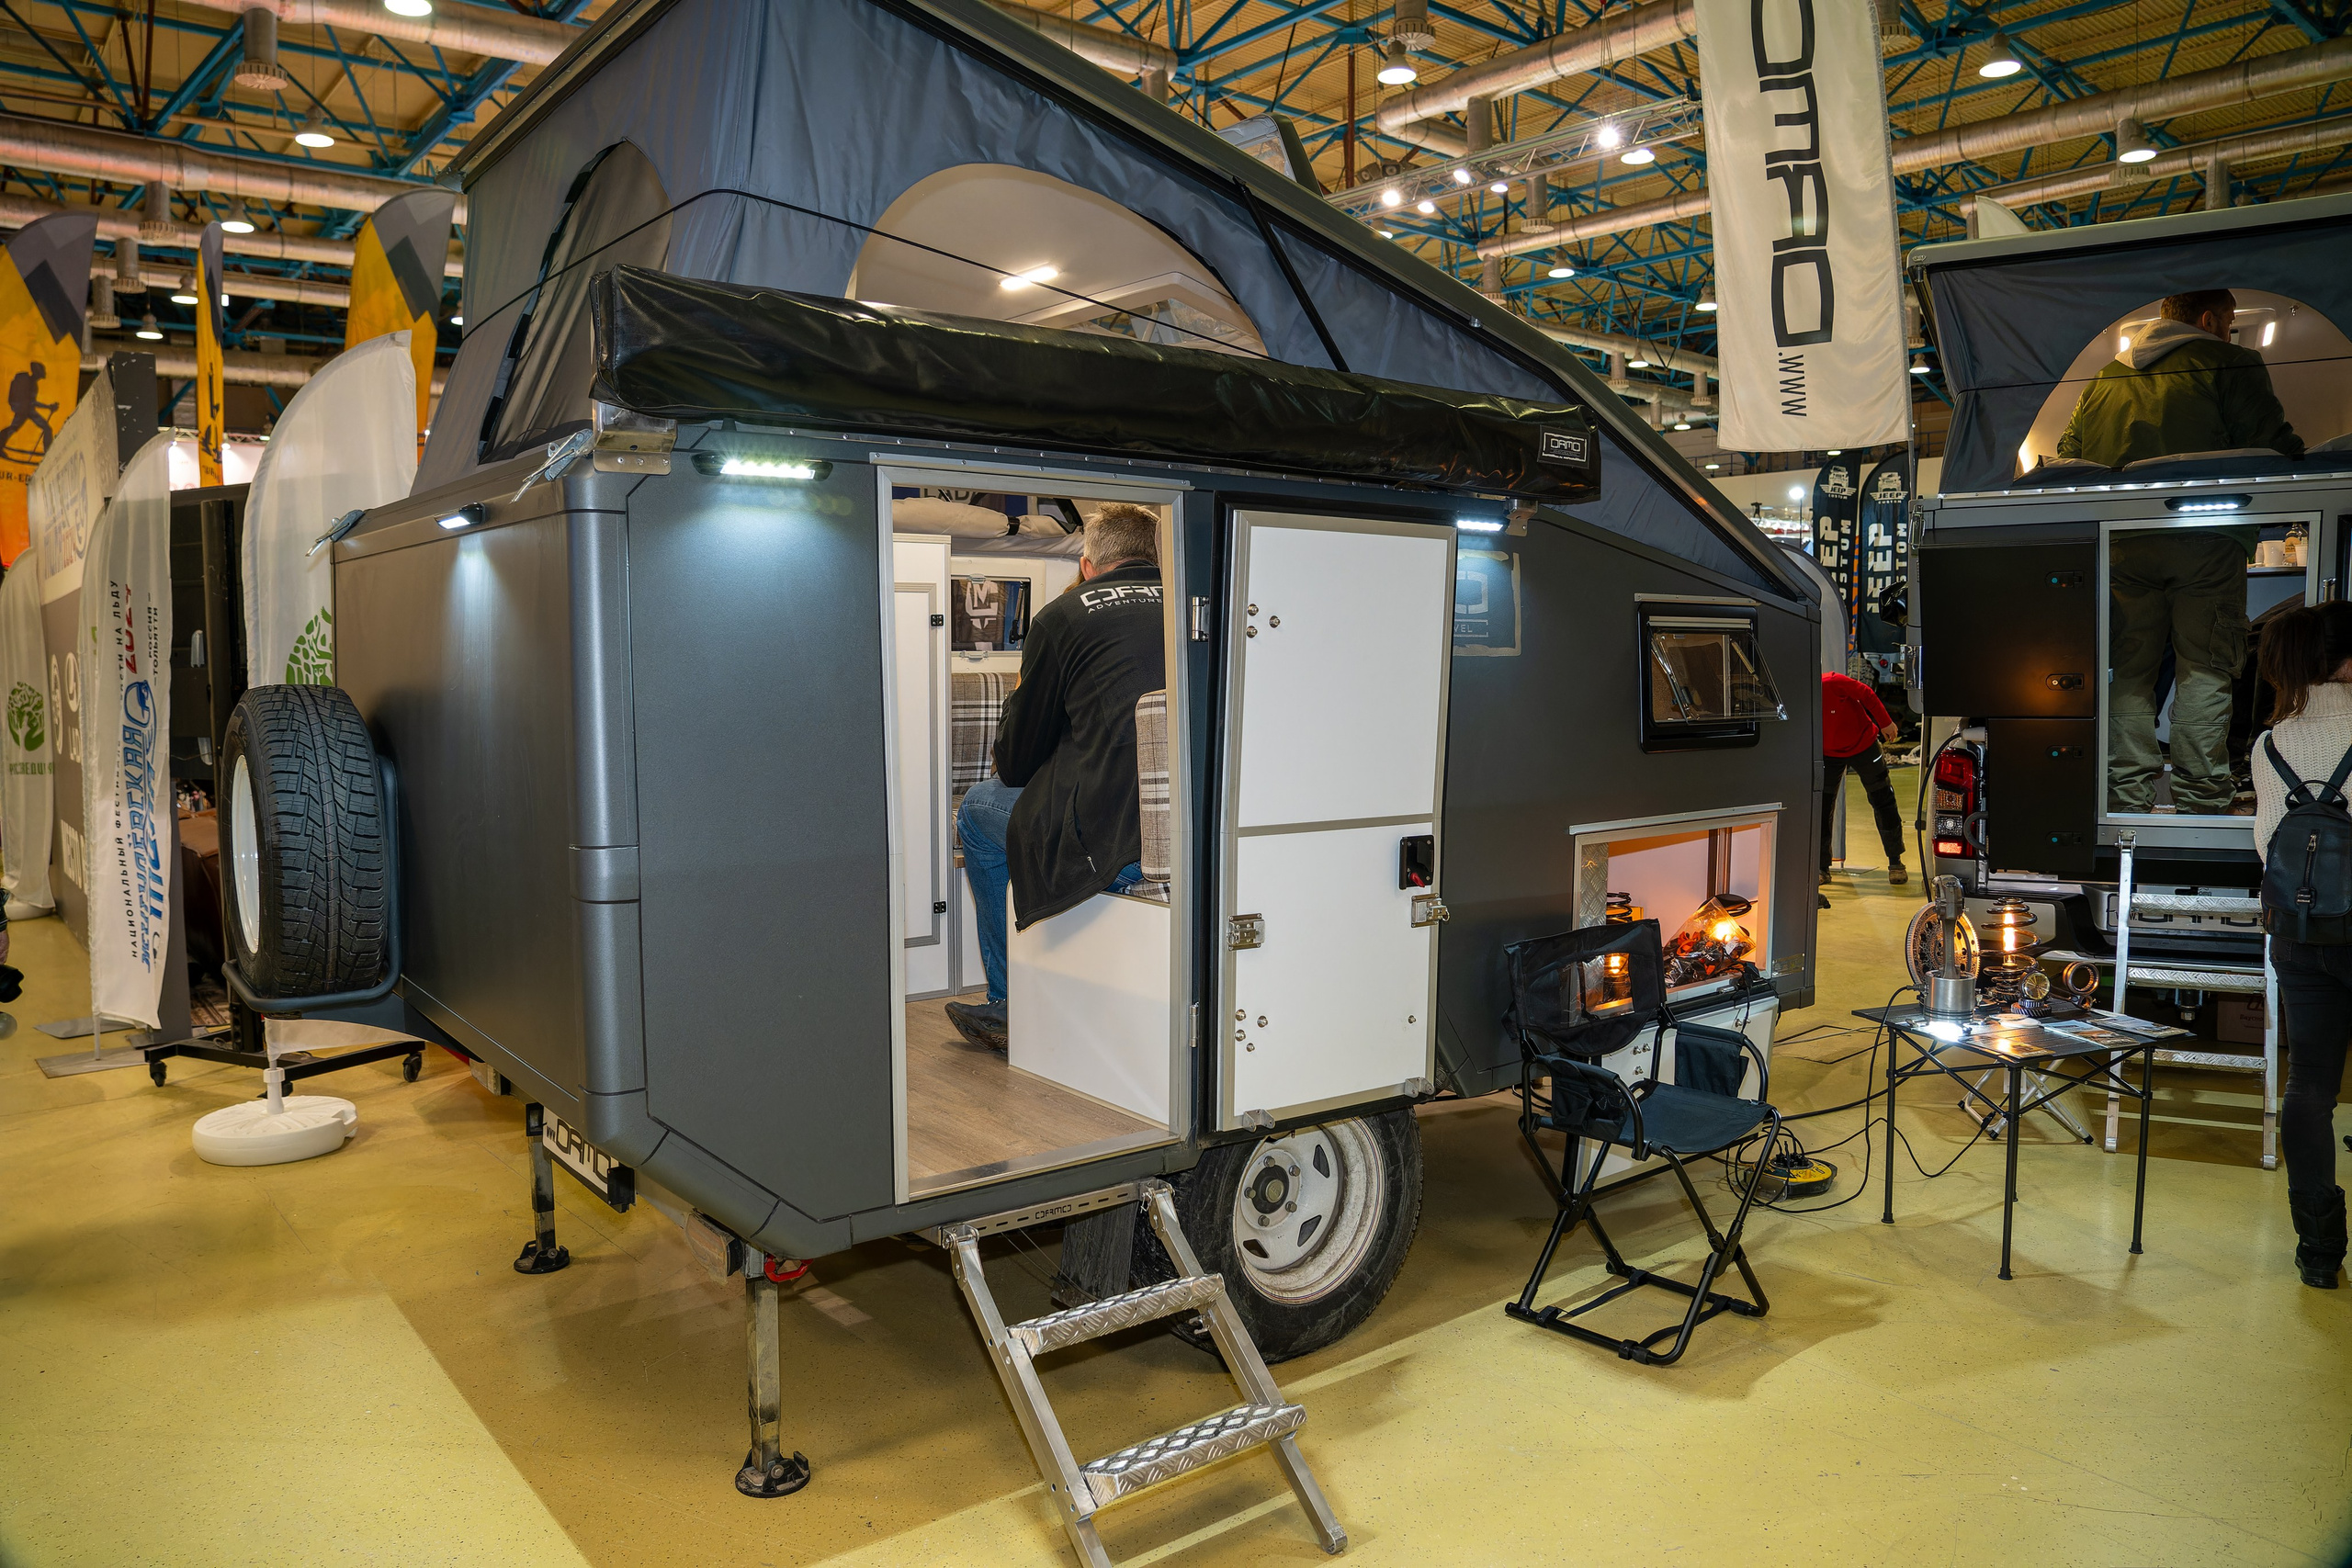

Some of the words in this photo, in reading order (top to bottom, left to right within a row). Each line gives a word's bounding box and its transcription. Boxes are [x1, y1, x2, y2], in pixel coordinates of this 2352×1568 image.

[1839, 519, 1851, 601] USTOM
[109, 581, 121, 618] ЛЬДУ
[115, 627, 123, 646] НА
